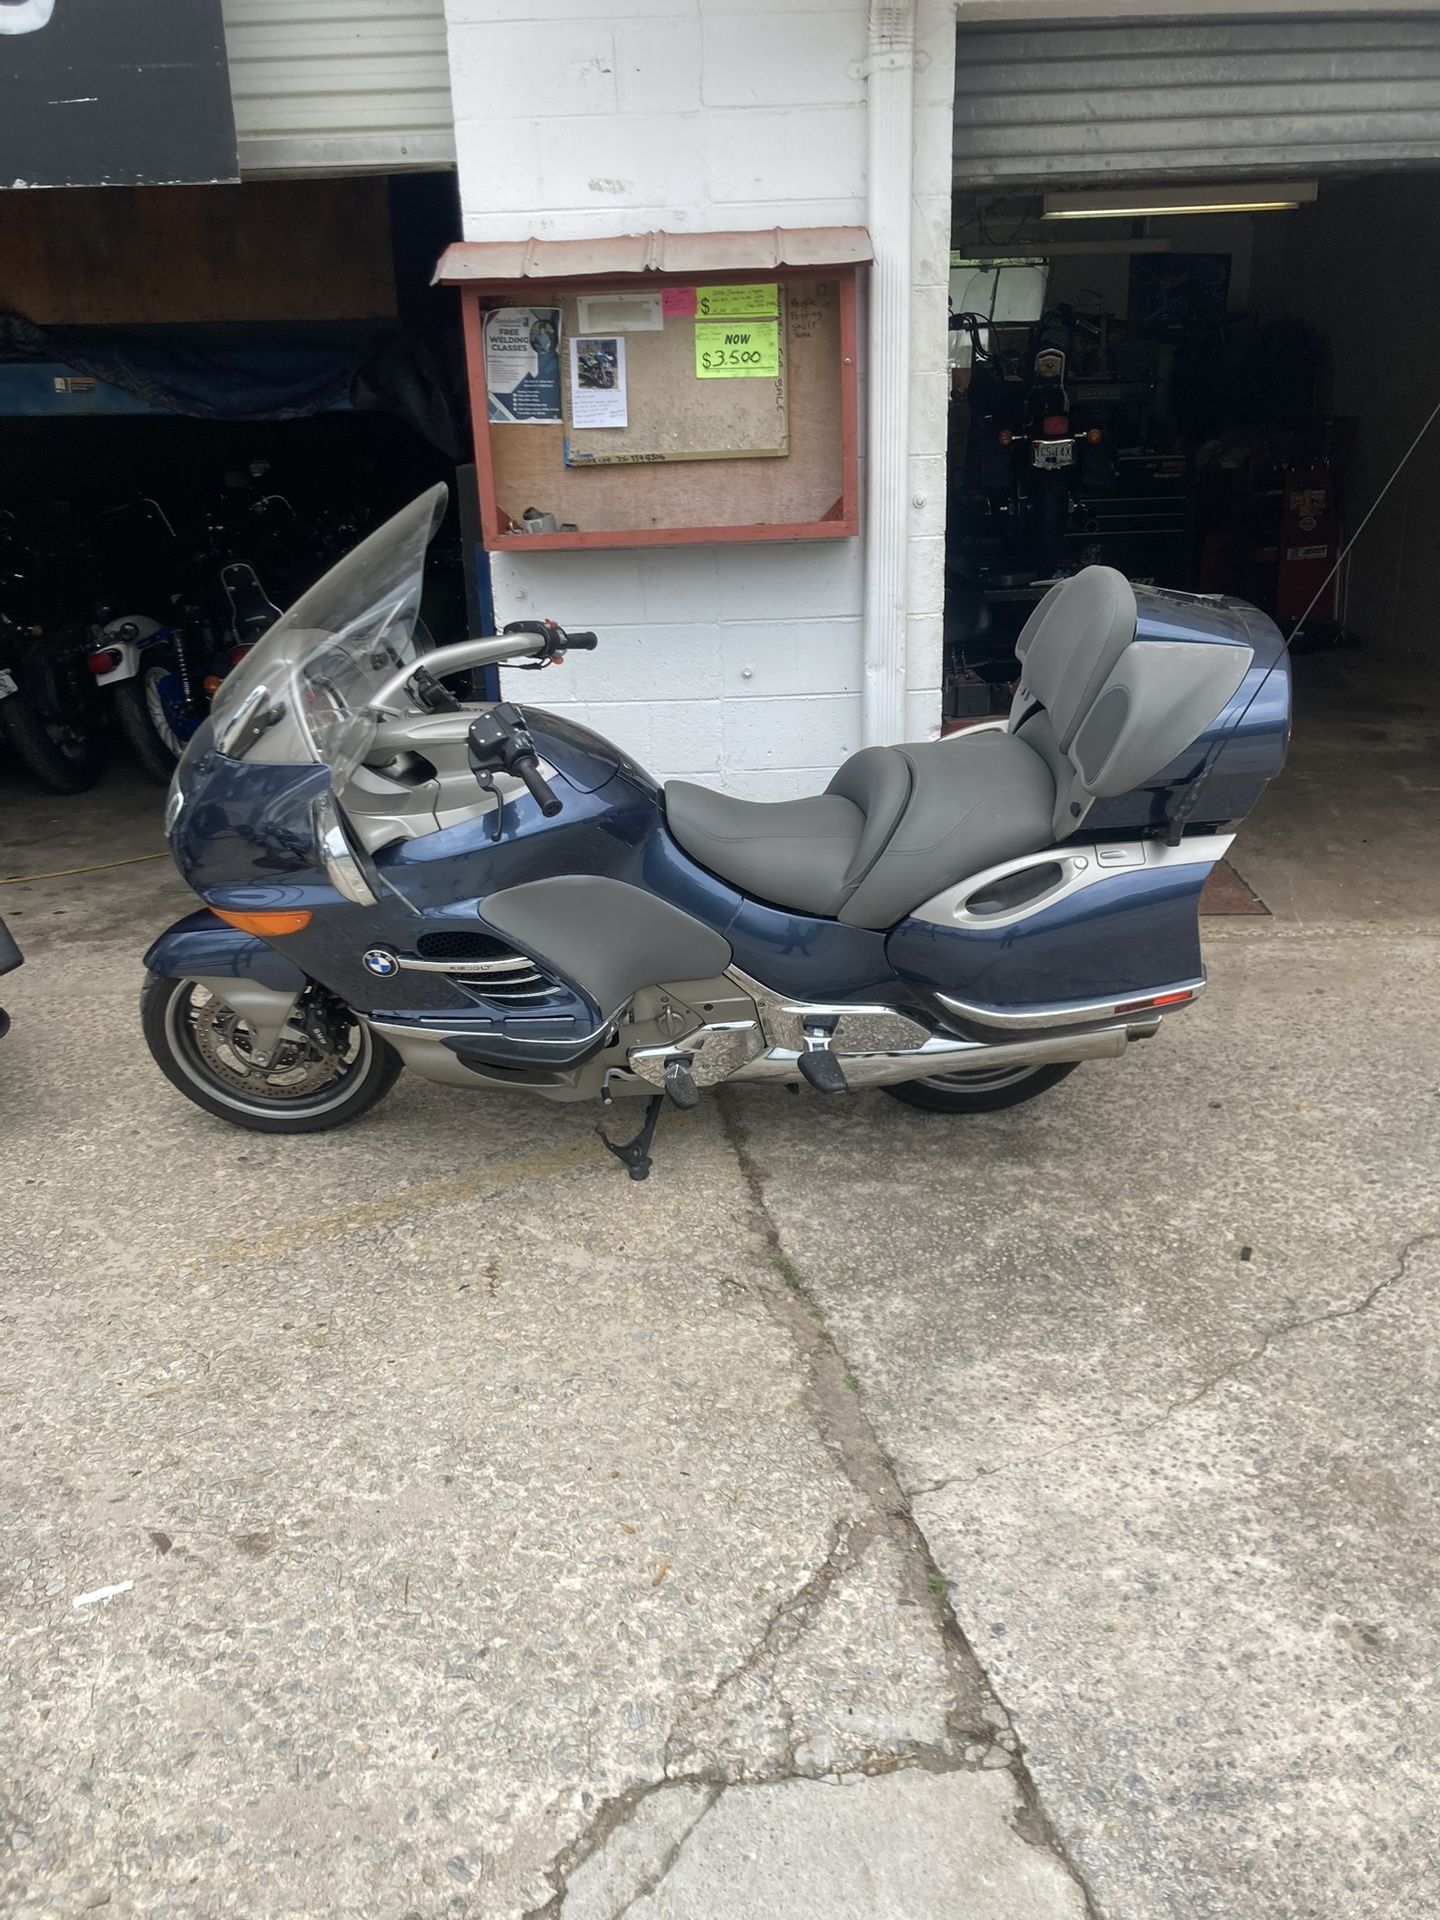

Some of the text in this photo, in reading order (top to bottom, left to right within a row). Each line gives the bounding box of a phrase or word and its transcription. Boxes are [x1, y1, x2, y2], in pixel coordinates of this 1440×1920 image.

[499, 328, 520, 336] FREE
[489, 336, 529, 344] WELDING
[724, 334, 751, 345] NOW
[491, 344, 528, 352] CLASSES
[774, 378, 784, 412] SALE
